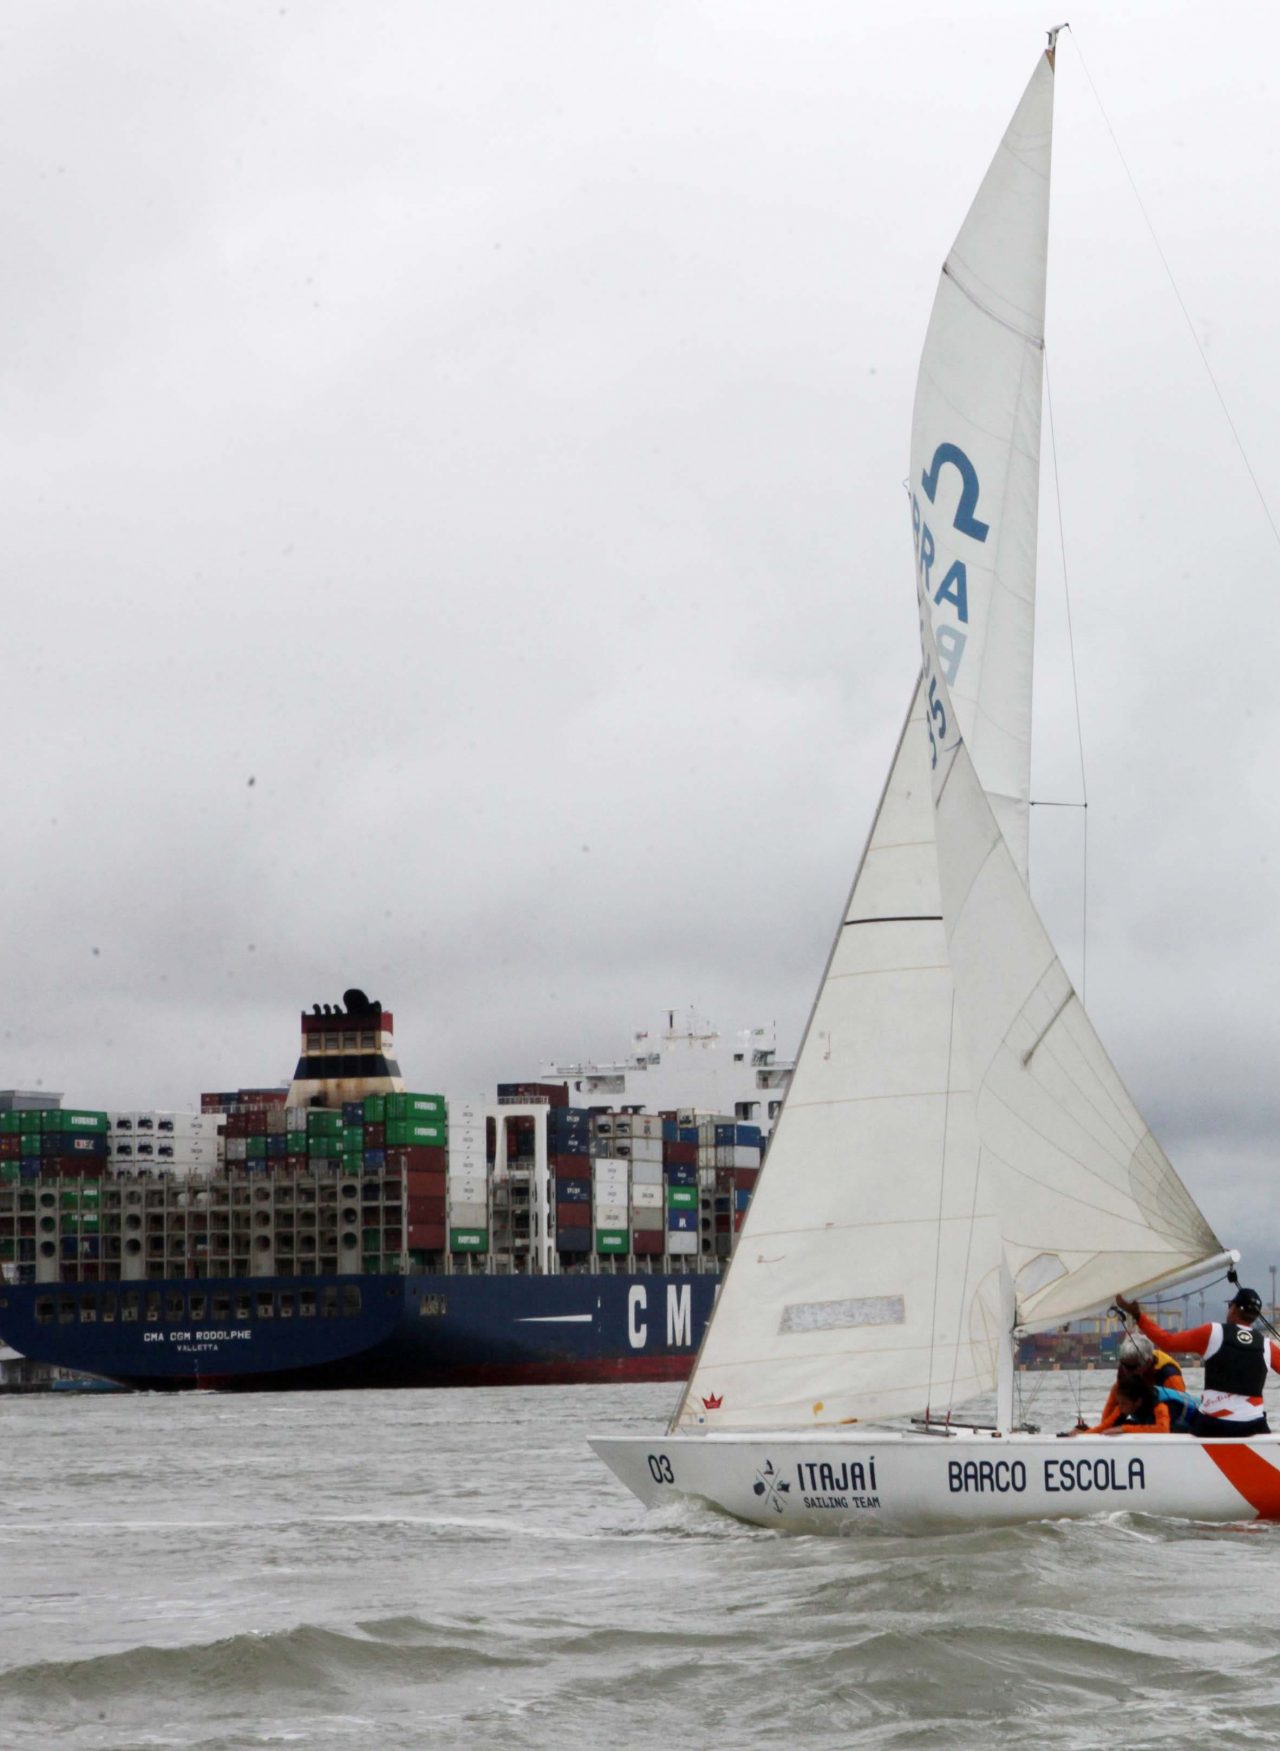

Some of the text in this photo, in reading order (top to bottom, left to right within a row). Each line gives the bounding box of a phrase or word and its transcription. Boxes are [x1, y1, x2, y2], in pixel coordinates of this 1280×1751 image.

[628, 1284, 721, 1349] CM
[143, 1330, 252, 1342] CMA CGM RODOLPHE
[177, 1344, 218, 1352] VALLETTA
[648, 1454, 675, 1484] 03
[797, 1456, 878, 1492] ITAJAÍ
[948, 1457, 1146, 1494] BARCO ESCOLA
[803, 1496, 881, 1509] SAILING TEAM
